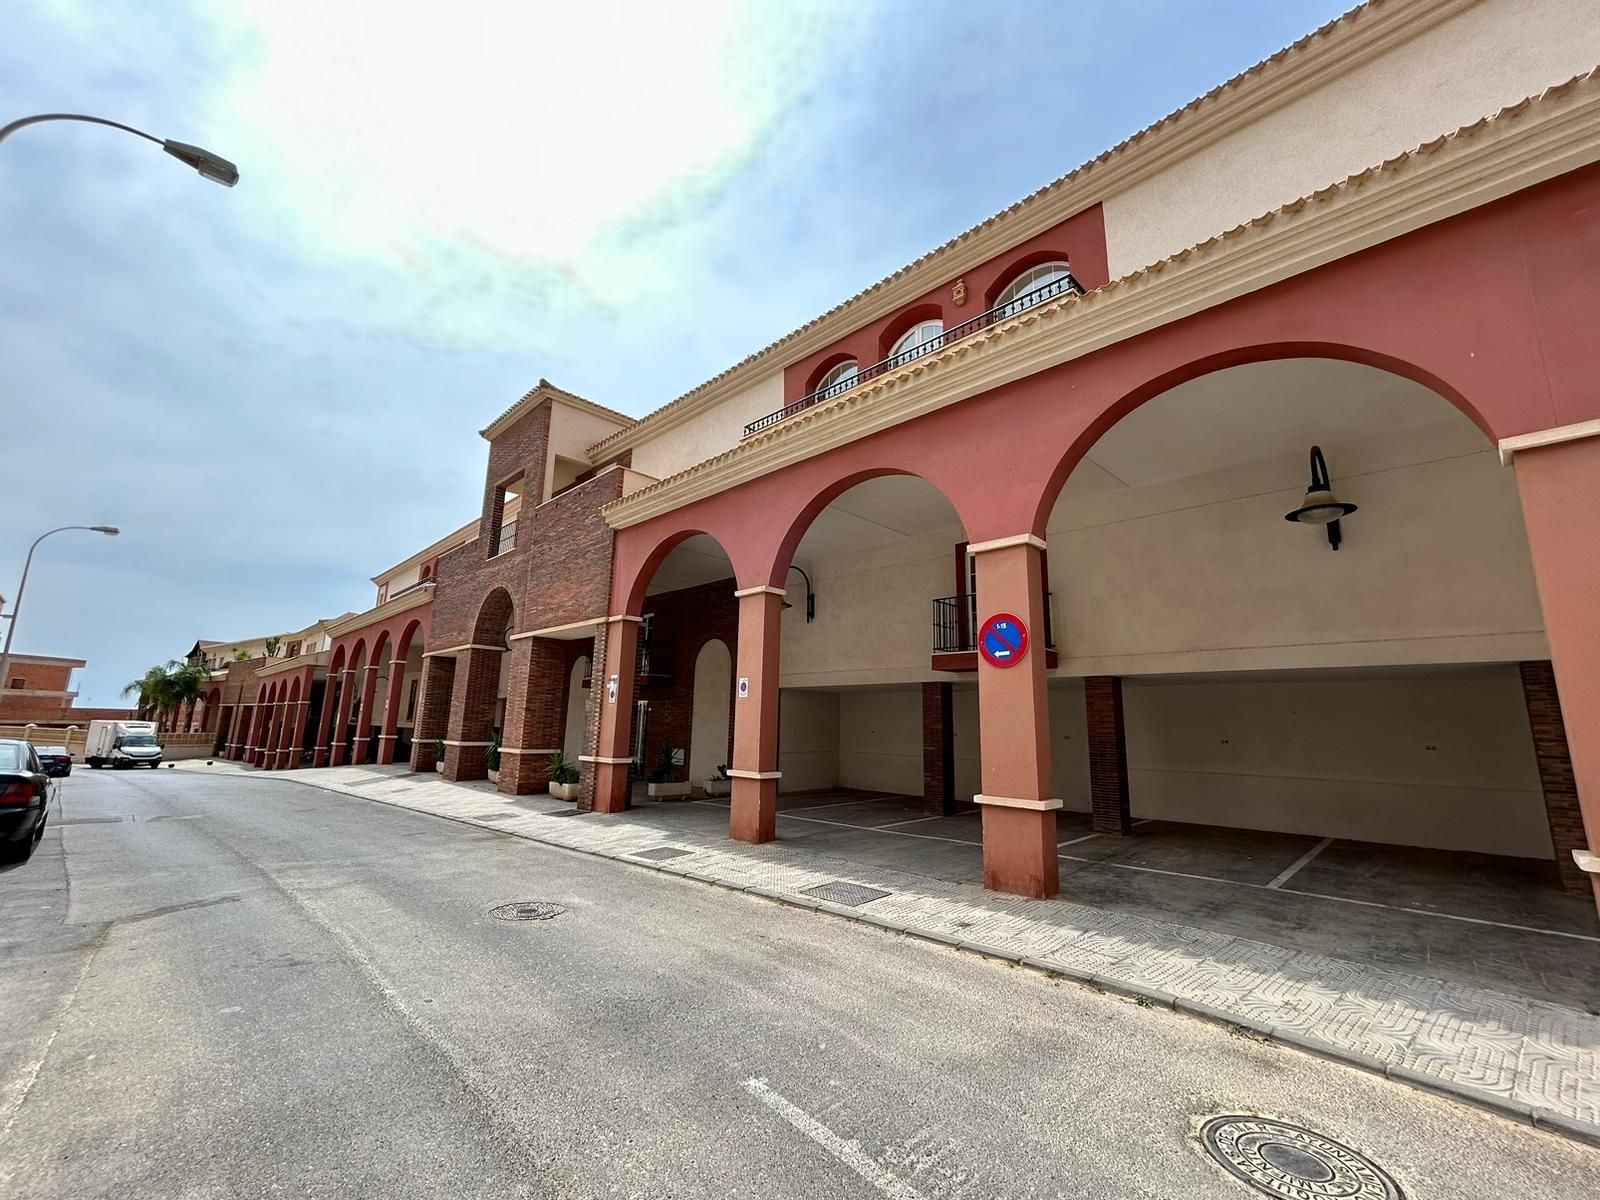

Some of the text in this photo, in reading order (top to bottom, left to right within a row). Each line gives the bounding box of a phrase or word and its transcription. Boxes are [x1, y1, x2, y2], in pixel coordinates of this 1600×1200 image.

[1230, 1123, 1269, 1133] MAR
[1219, 1132, 1234, 1146] DE
[1295, 1133, 1385, 1200] AYUNTAMIENT
